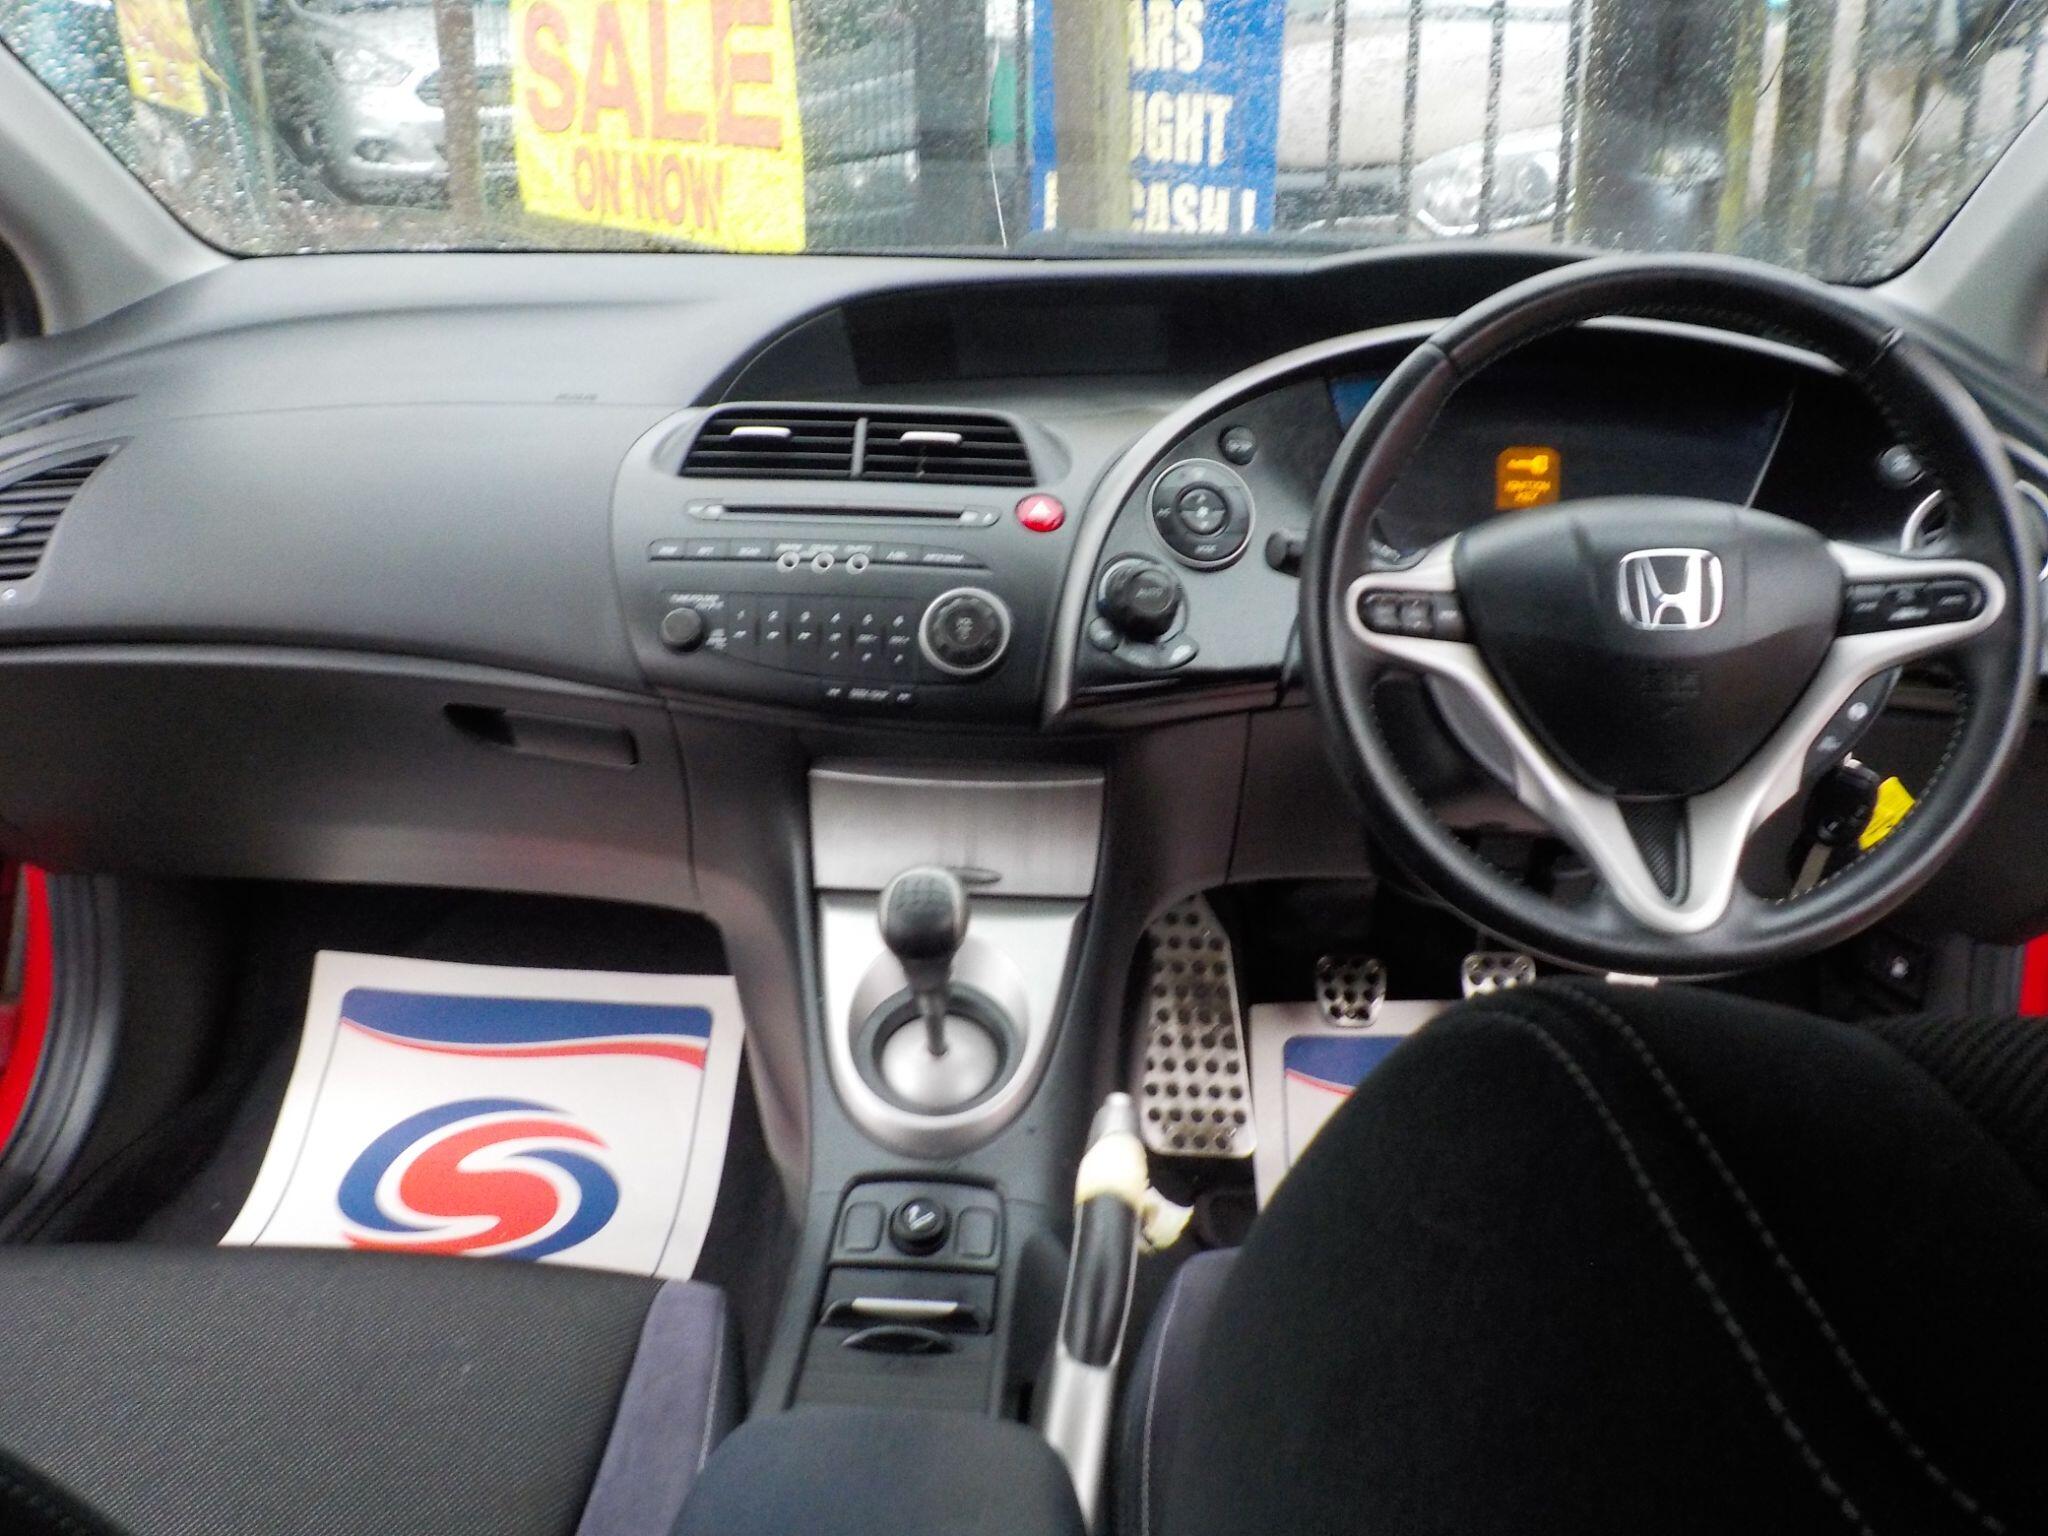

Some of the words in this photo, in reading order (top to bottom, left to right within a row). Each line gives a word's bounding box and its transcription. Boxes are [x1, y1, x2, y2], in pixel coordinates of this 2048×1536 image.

[523, 0, 783, 150] SALE
[1127, 0, 1204, 73] ARS
[1129, 90, 1234, 167] UGHT
[574, 146, 622, 216] ON
[631, 151, 723, 232] NOW
